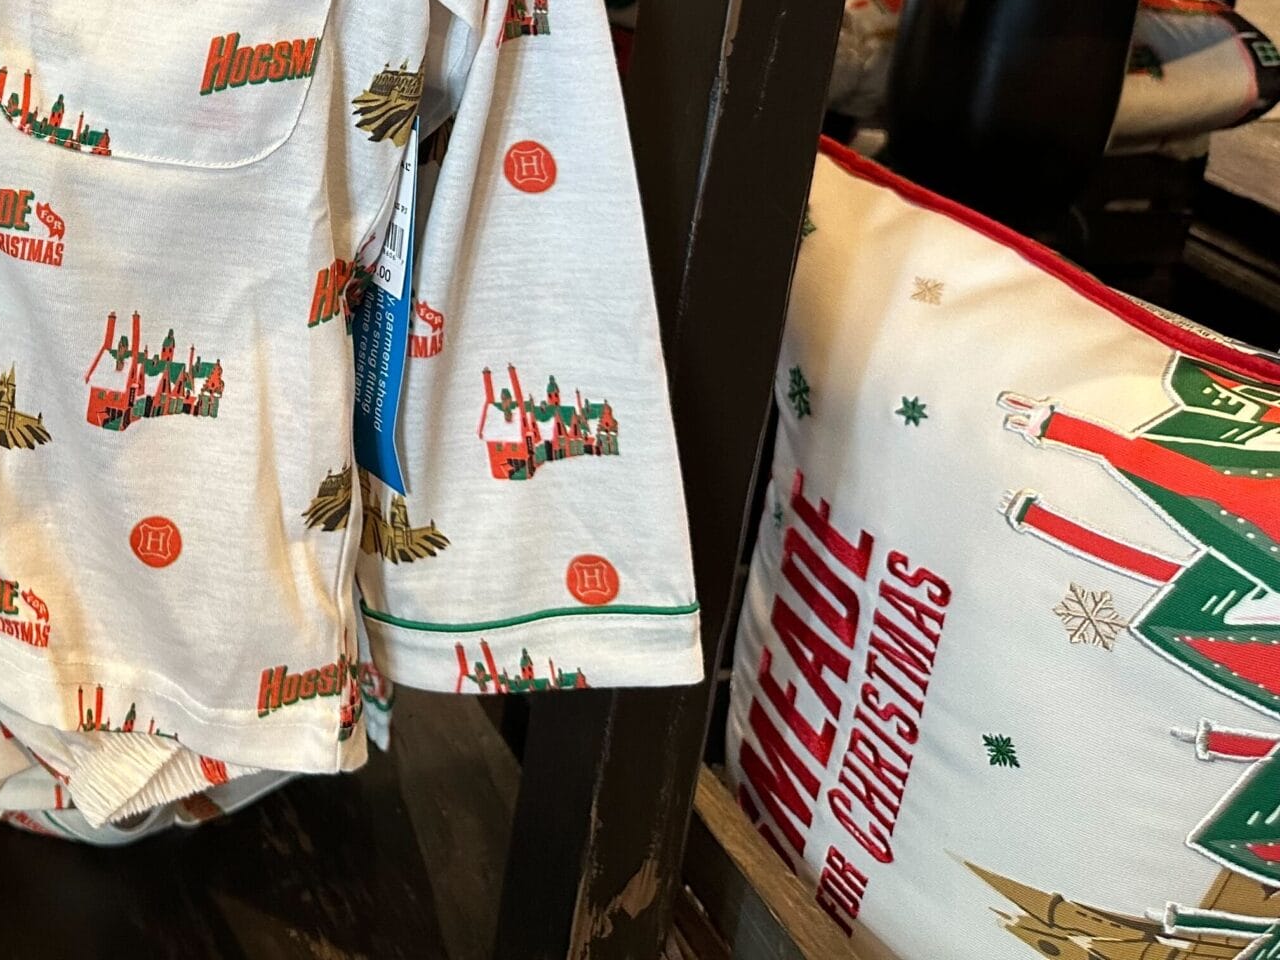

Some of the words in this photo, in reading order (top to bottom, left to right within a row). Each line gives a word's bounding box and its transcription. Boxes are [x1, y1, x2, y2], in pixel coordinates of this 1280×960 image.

[381, 310, 394, 377] garment
[373, 380, 387, 432] should
[827, 549, 953, 864] CHRISTMAS
[815, 845, 869, 938] FOR
